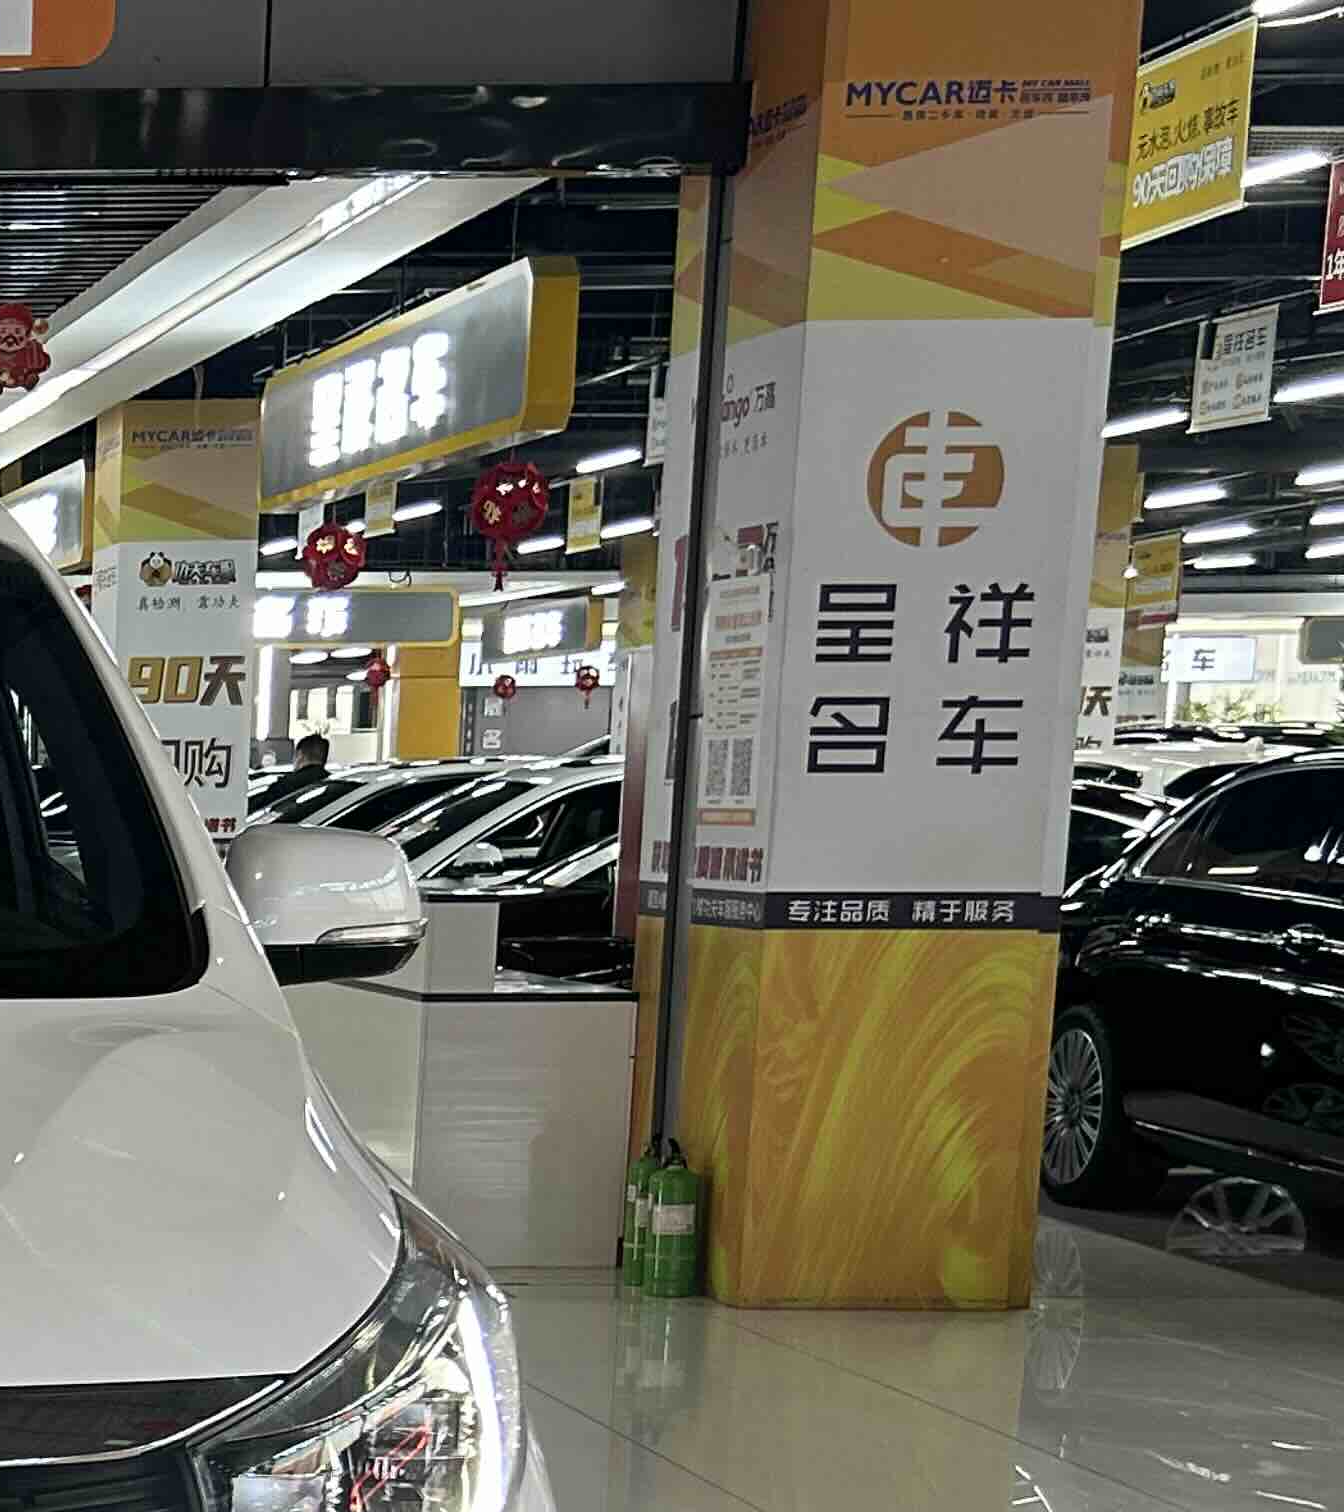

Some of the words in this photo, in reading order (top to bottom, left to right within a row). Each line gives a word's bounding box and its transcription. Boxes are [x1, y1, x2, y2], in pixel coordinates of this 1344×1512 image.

[816, 581, 1035, 665] 呈祥
[128, 655, 246, 706] 90天
[805, 695, 1024, 776] 名车
[788, 900, 890, 923] 专注品质
[912, 900, 1016, 923] 精于服务
